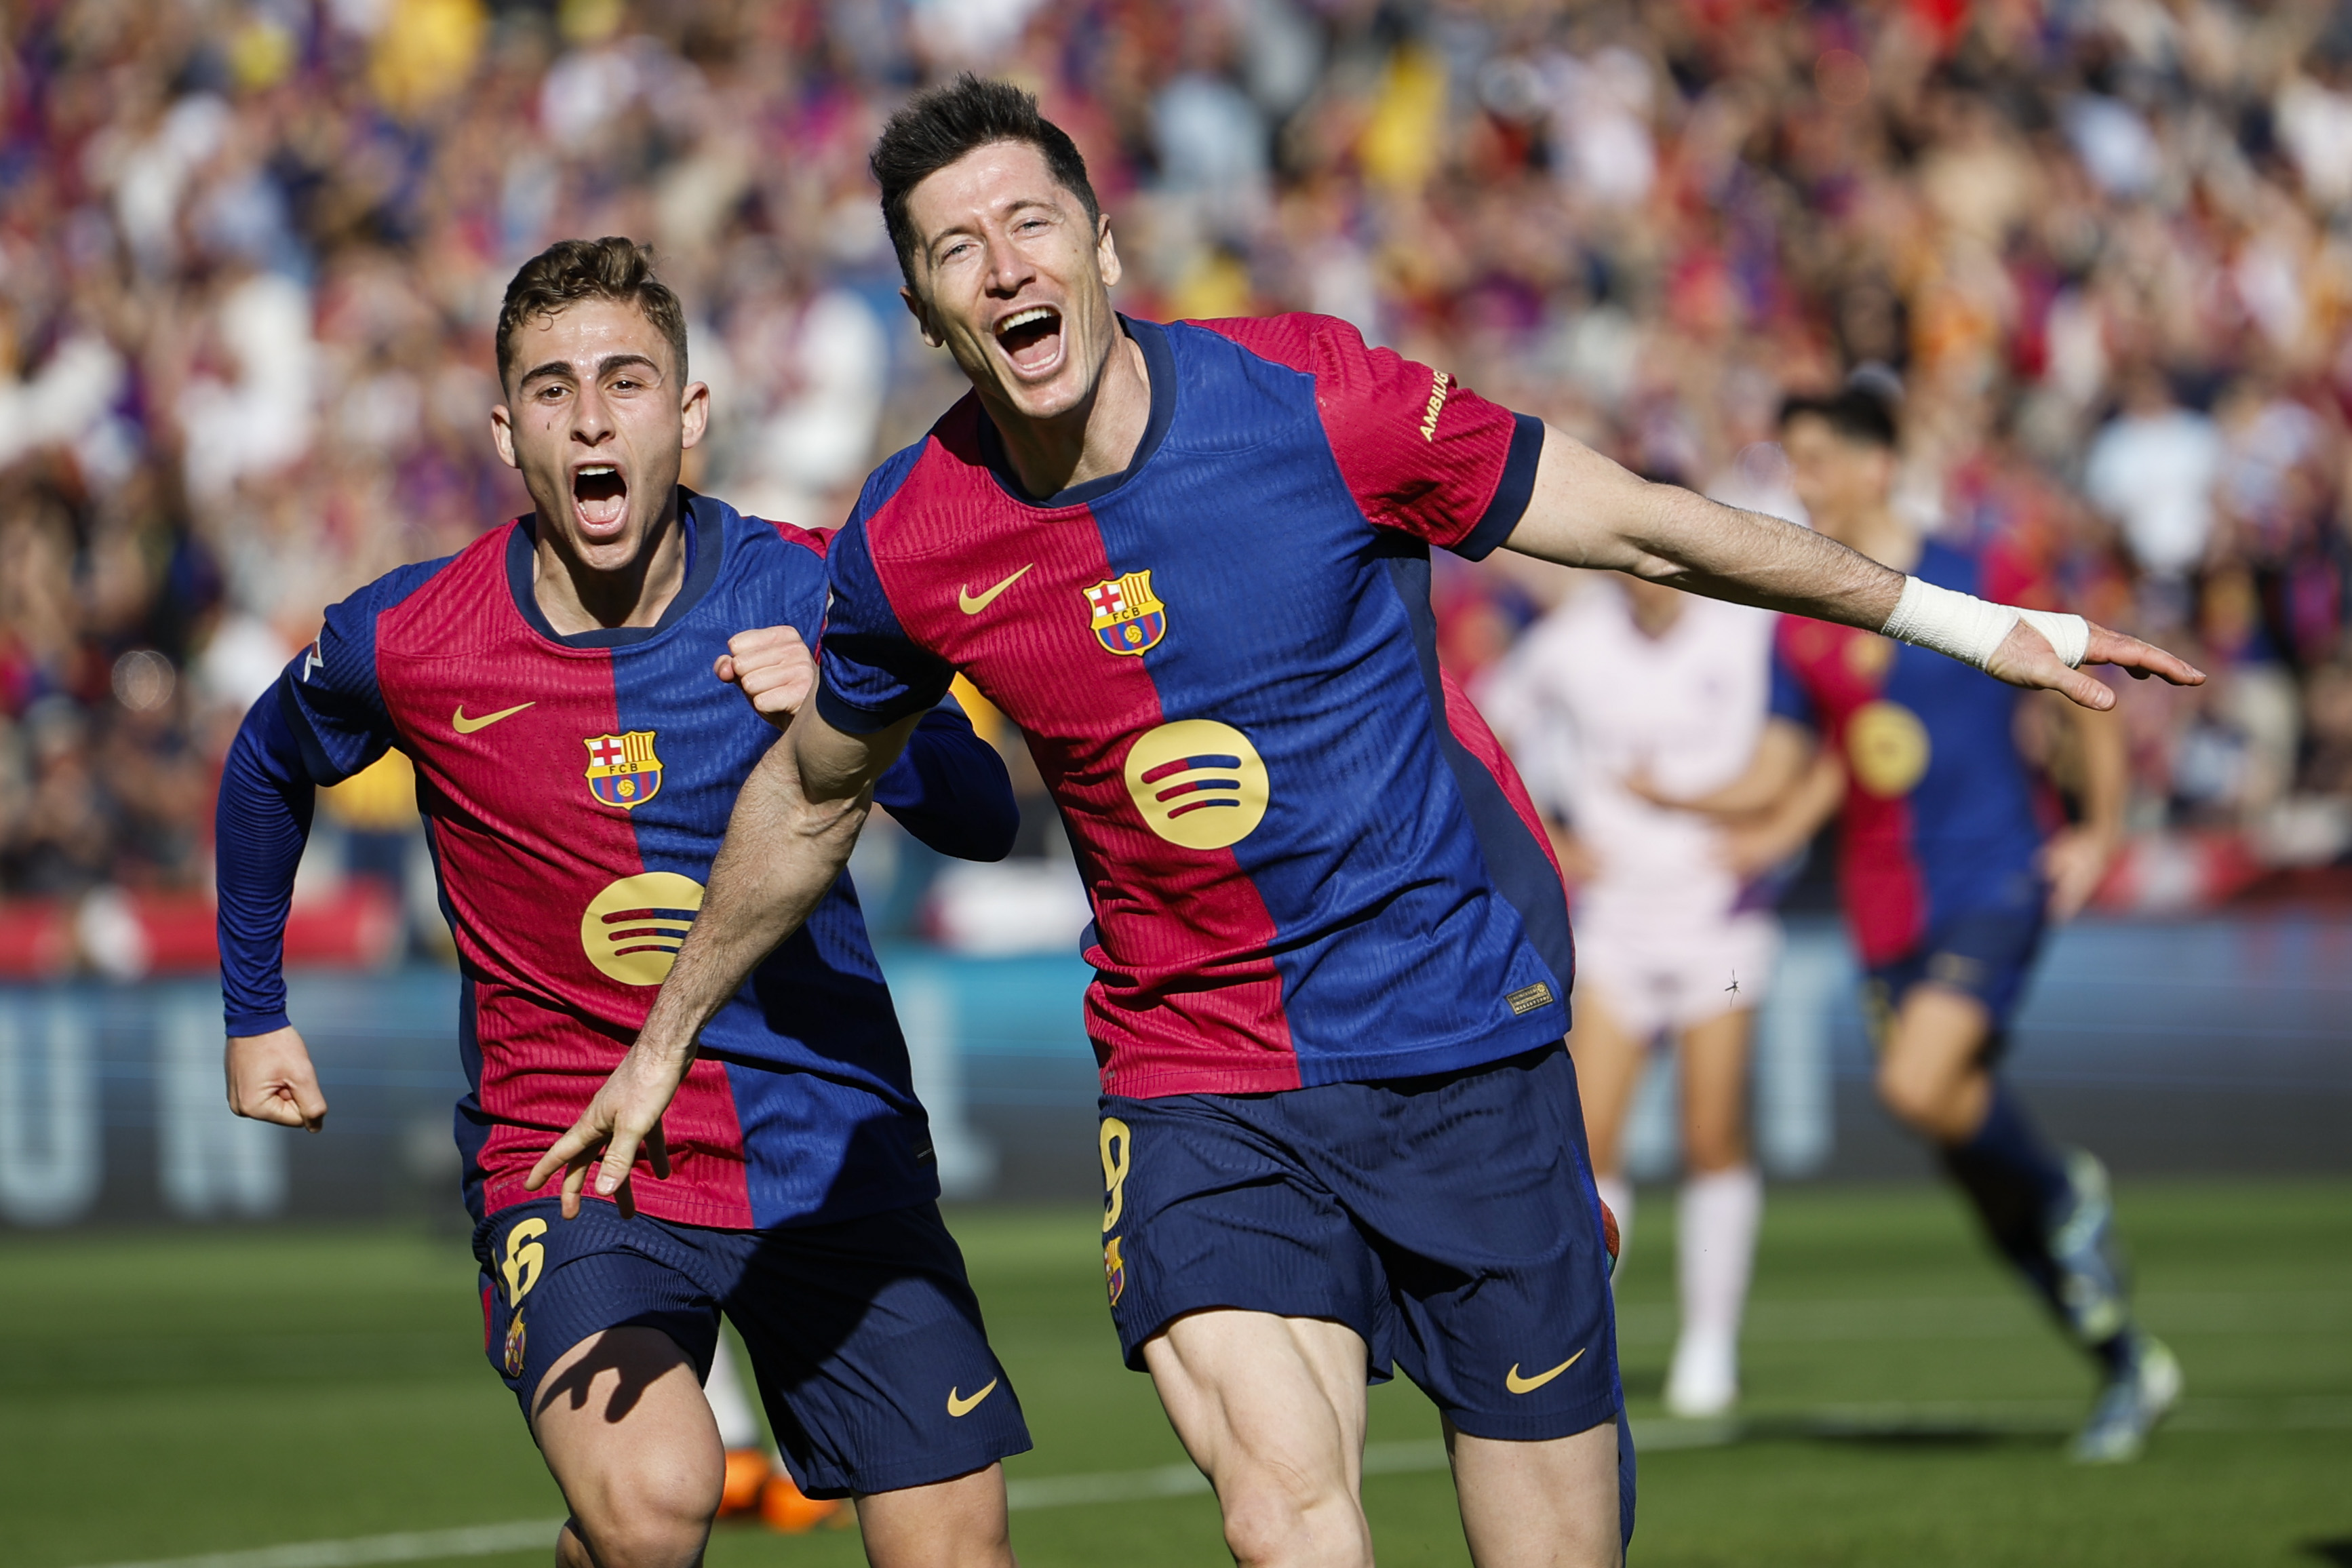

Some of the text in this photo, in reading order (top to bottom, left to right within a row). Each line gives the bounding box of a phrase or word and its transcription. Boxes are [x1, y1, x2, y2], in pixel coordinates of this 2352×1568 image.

[1419, 369, 1449, 442] AMBILIG
[1112, 607, 1140, 623] FCB
[609, 763, 638, 775] FCB
[1099, 1117, 1131, 1233] 9
[491, 1217, 547, 1310] 6
